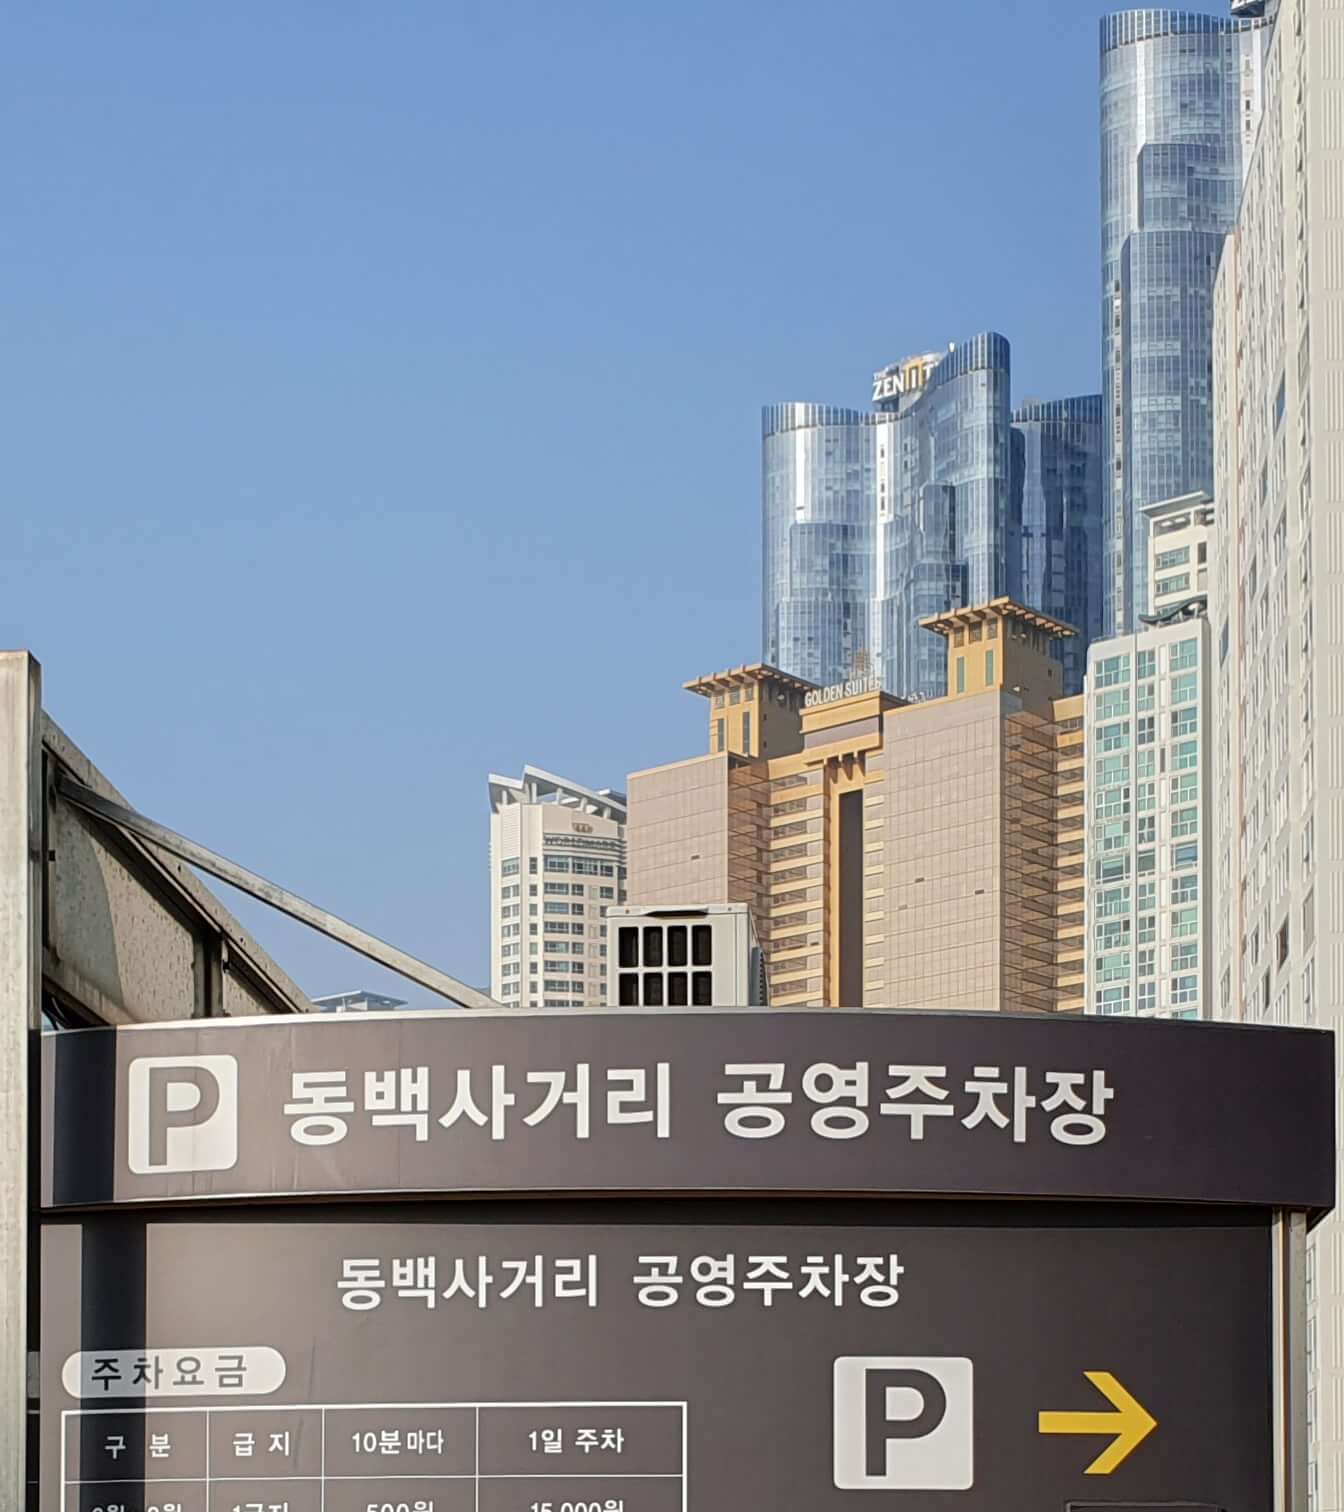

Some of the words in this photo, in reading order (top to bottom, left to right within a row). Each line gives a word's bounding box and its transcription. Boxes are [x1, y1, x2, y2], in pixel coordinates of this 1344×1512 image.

[805, 683, 843, 707] GOLDEN
[284, 1063, 669, 1145] 동백사거리
[717, 1062, 1113, 1145] 공영주차장
[338, 1255, 598, 1310] 동백사거리
[633, 1254, 904, 1307] 공영주차장
[91, 1355, 248, 1390] 주차요금
[576, 1429, 624, 1454] 주차
